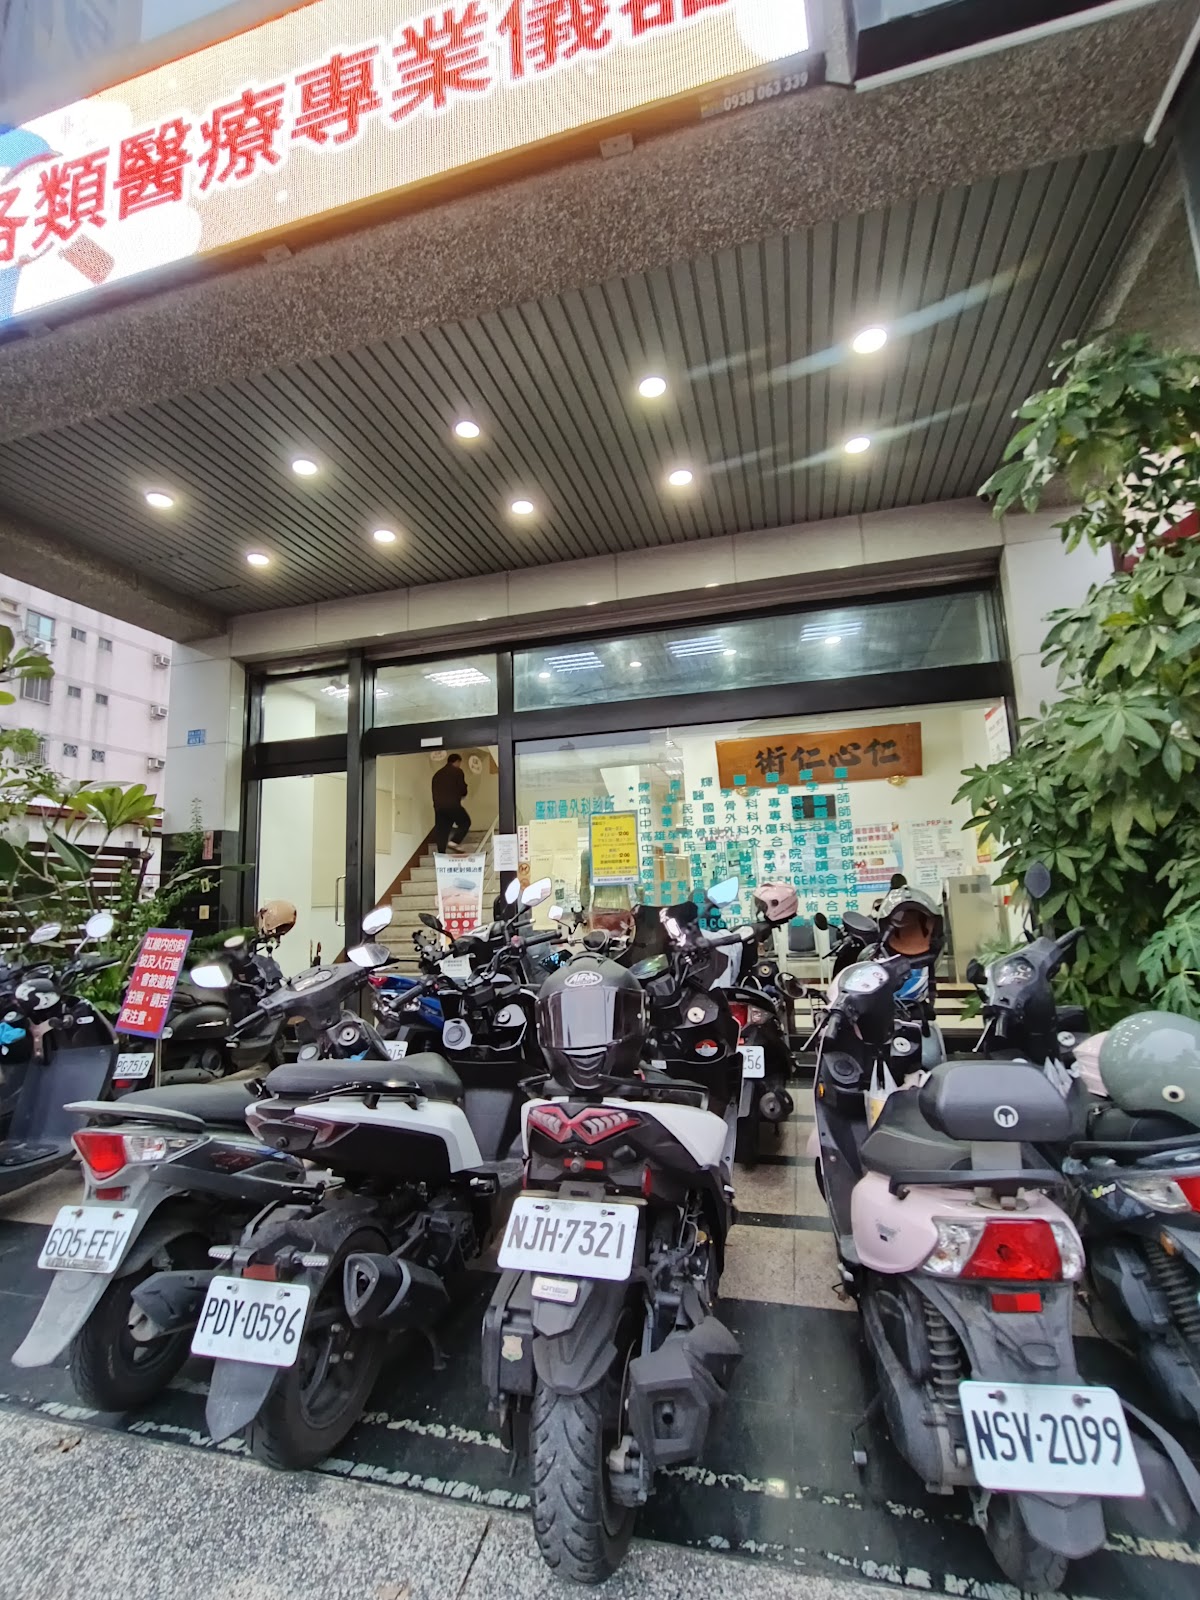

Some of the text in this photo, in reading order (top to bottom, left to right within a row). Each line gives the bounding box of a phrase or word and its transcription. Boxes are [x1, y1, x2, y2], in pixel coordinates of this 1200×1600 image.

[723, 89, 755, 111] 0938
[757, 80, 781, 100] 063
[783, 71, 808, 92] 339
[138, 953, 182, 972] 坡及人行道
